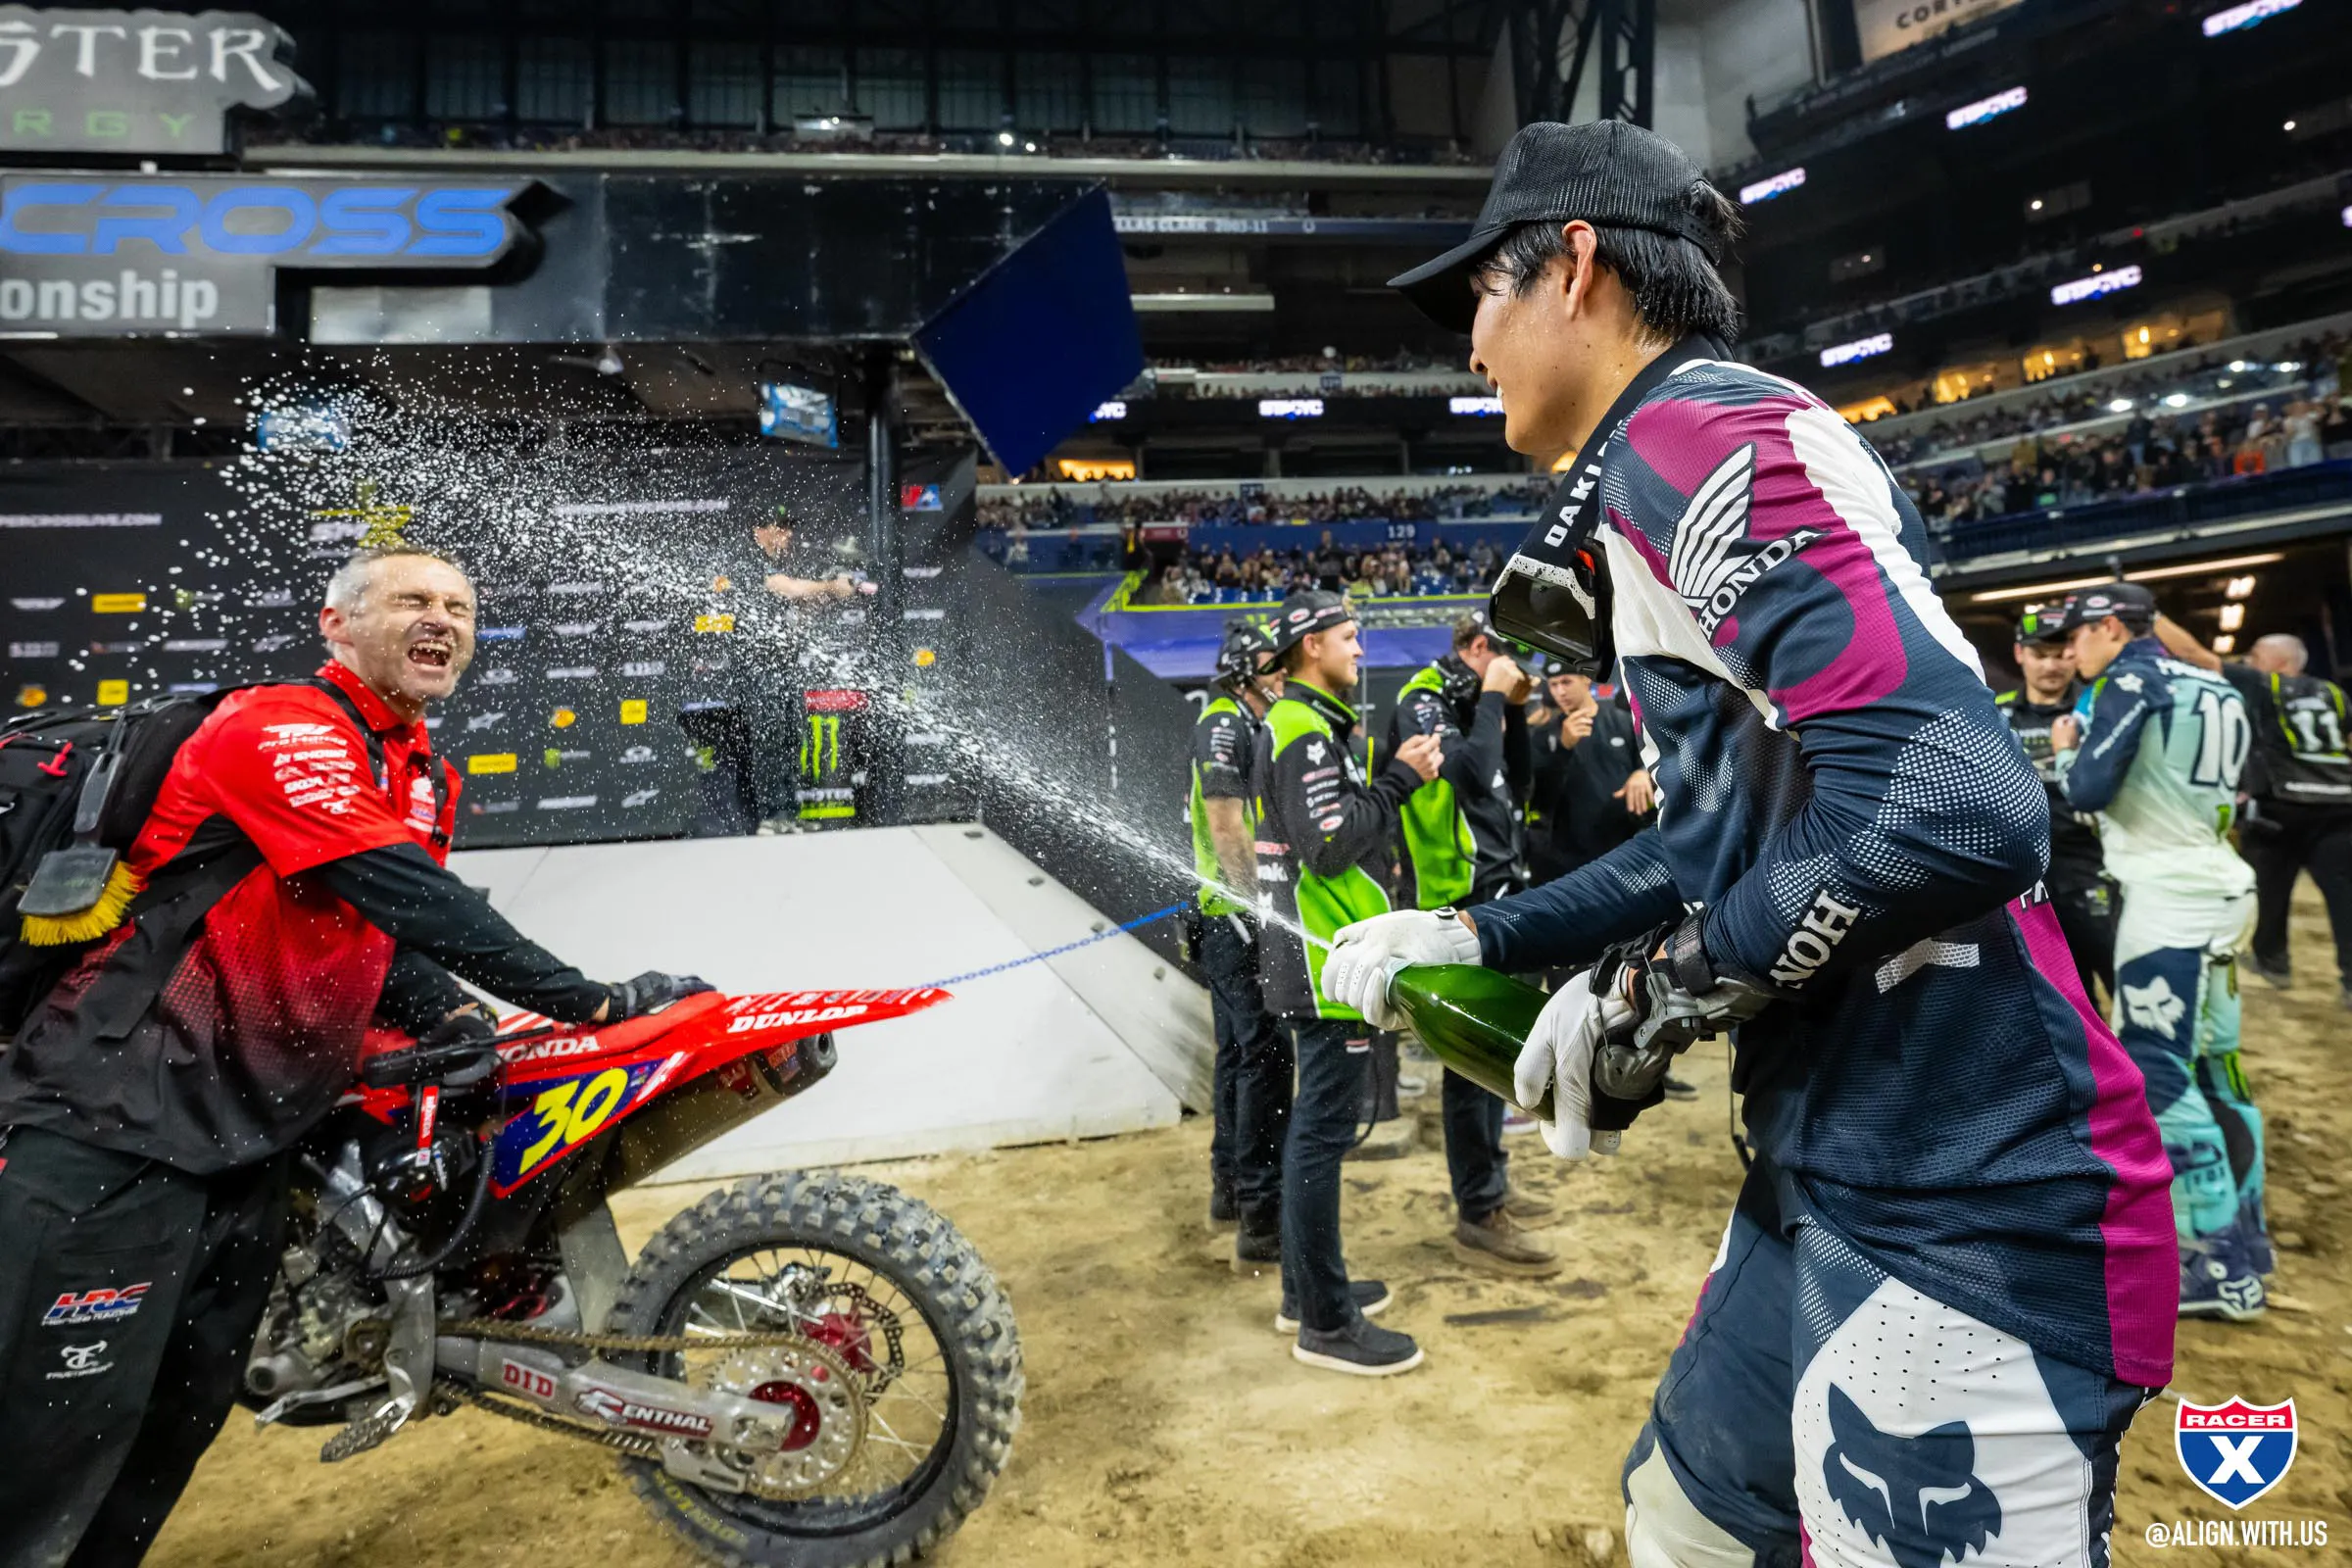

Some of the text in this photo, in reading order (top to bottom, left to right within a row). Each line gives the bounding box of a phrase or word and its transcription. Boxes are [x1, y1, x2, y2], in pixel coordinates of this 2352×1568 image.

[0, 182, 511, 255] CROSS
[0, 269, 220, 330] onship
[1388, 523, 1416, 539] 129
[1697, 529, 1826, 642] HONDA
[2192, 689, 2252, 790] 10
[726, 1004, 868, 1034] DUNLOP
[517, 1067, 628, 1176] 30
[502, 1363, 556, 1397] DID
